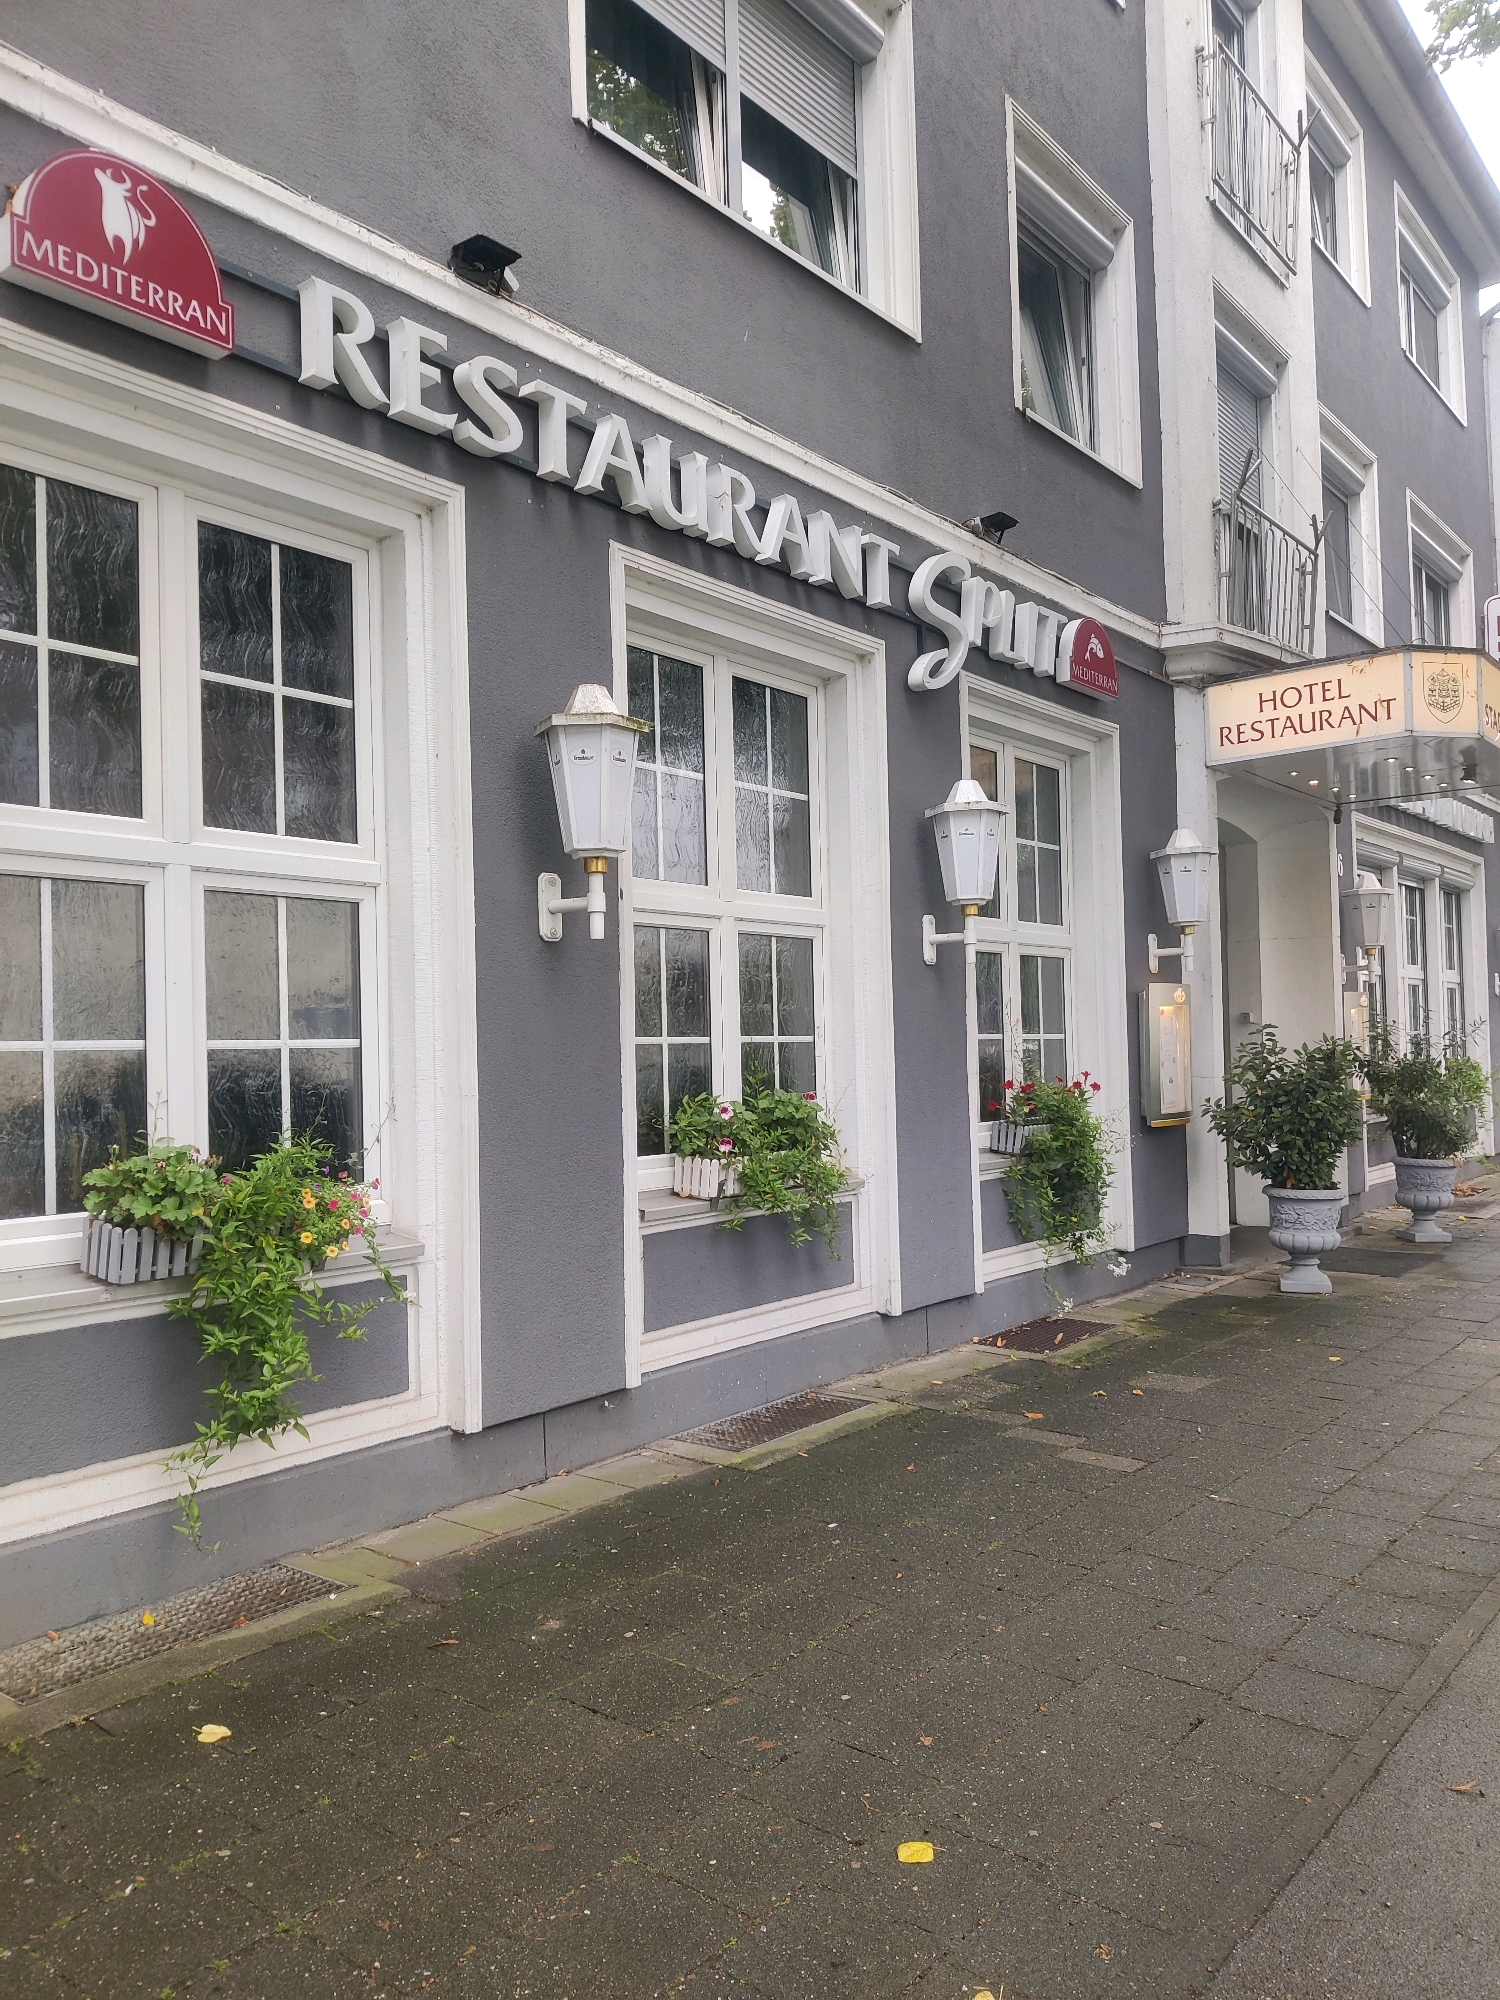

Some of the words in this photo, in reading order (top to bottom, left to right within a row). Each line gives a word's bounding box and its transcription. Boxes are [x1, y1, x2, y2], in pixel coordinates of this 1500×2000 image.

[21, 230, 227, 337] MEDITERRAN
[297, 275, 900, 610] RESTAURANT
[1071, 662, 1119, 693] MEDITERRAN
[1258, 678, 1352, 713] HOTEL
[1218, 698, 1397, 748] RESTAURANT
